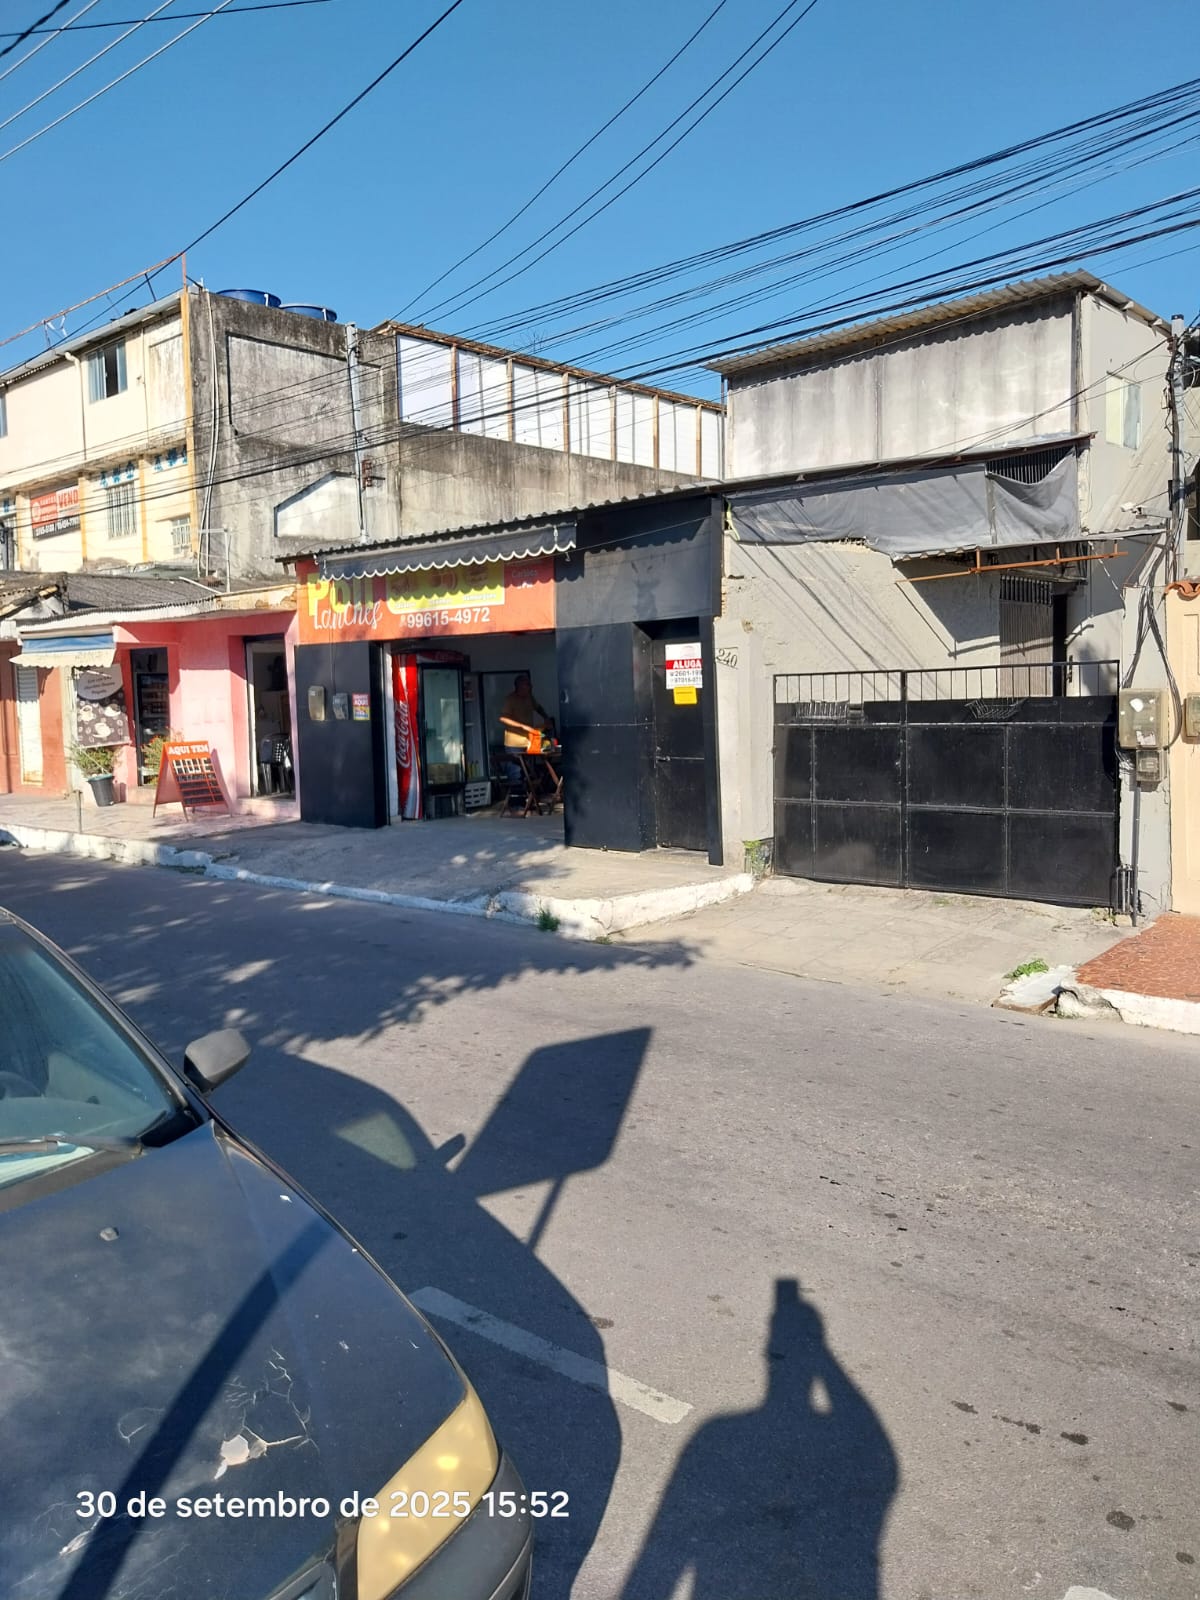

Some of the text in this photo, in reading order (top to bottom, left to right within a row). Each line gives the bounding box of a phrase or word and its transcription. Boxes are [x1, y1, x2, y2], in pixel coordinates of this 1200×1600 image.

[407, 607, 490, 628] 99615-4972
[673, 660, 702, 669] ALUGA
[716, 648, 738, 667] 240
[168, 745, 190, 756] AQUI
[173, 757, 211, 775] HOJE
